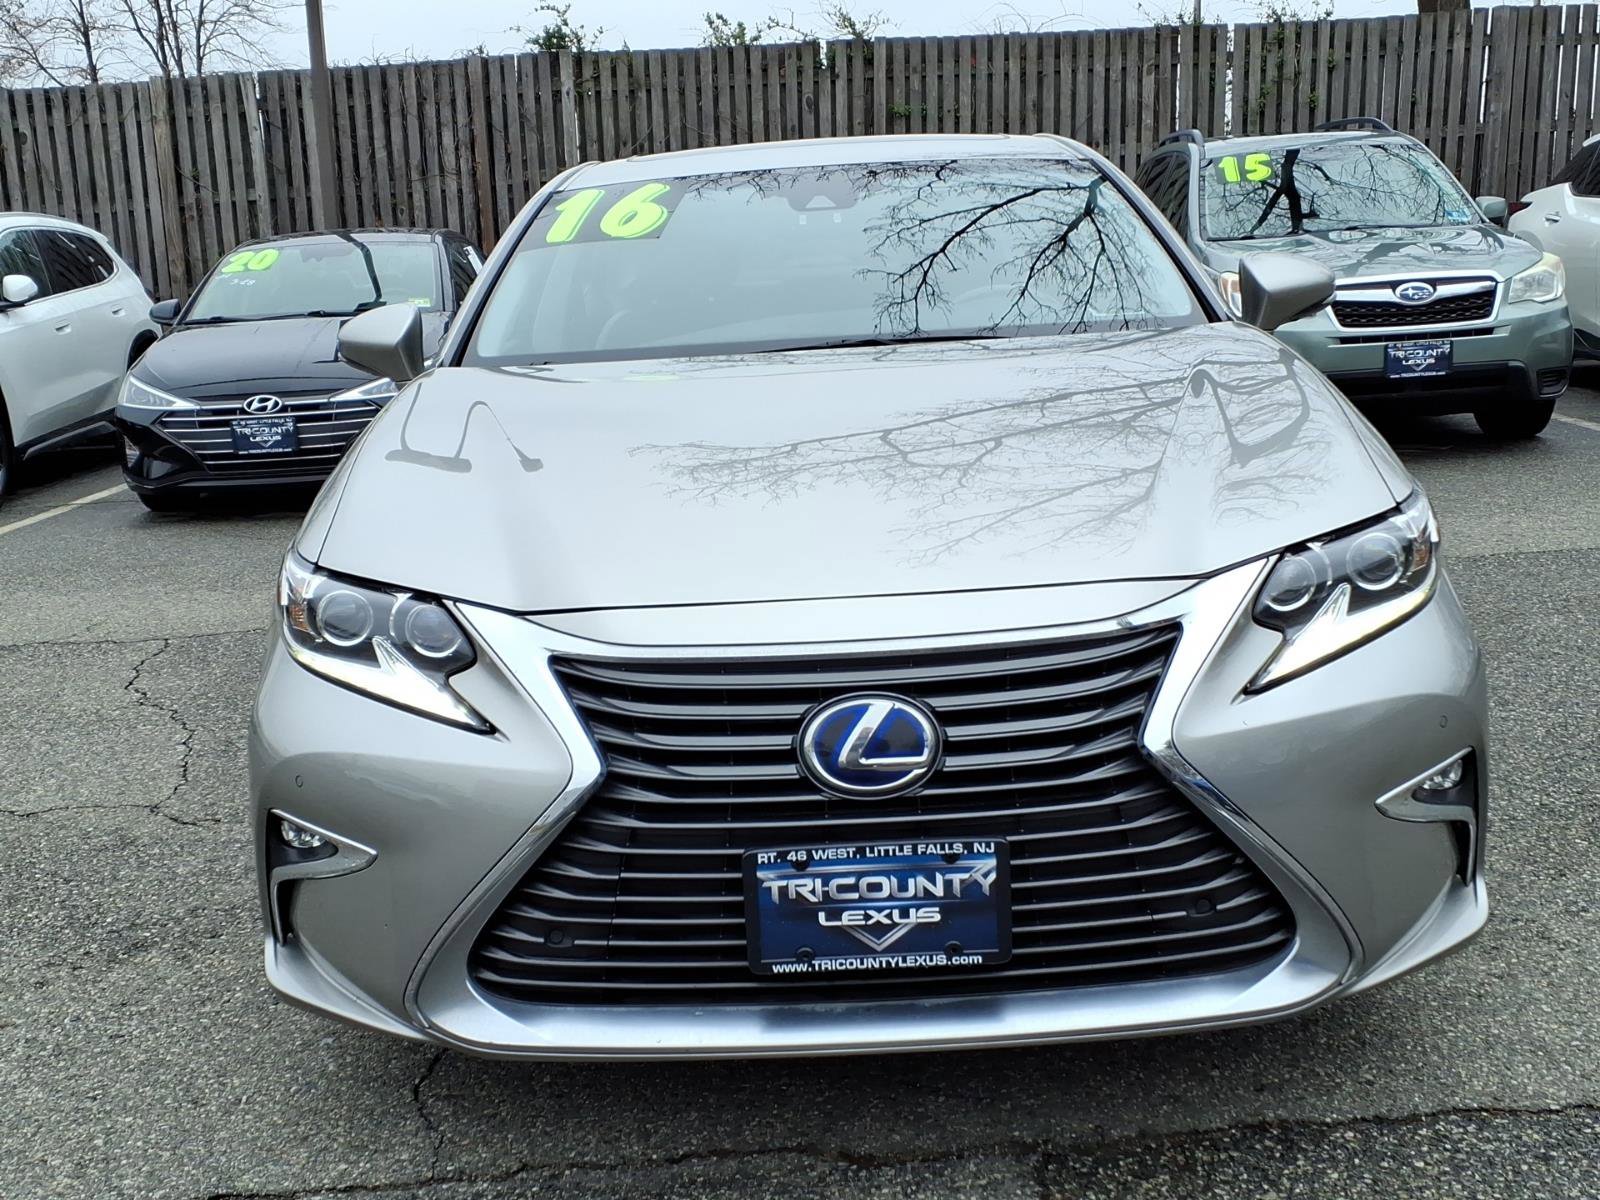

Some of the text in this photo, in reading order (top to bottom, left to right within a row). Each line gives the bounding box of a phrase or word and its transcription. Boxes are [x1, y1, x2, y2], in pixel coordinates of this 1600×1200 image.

[1218, 155, 1272, 184] 15
[545, 182, 671, 244] 16
[221, 248, 279, 273] 20
[757, 842, 995, 865] RT. 46 WEST, LITTLE FALLS, NJ
[818, 907, 942, 926] LEXUS
[772, 954, 983, 974] www.TRICOUNTYLEXUS.com
